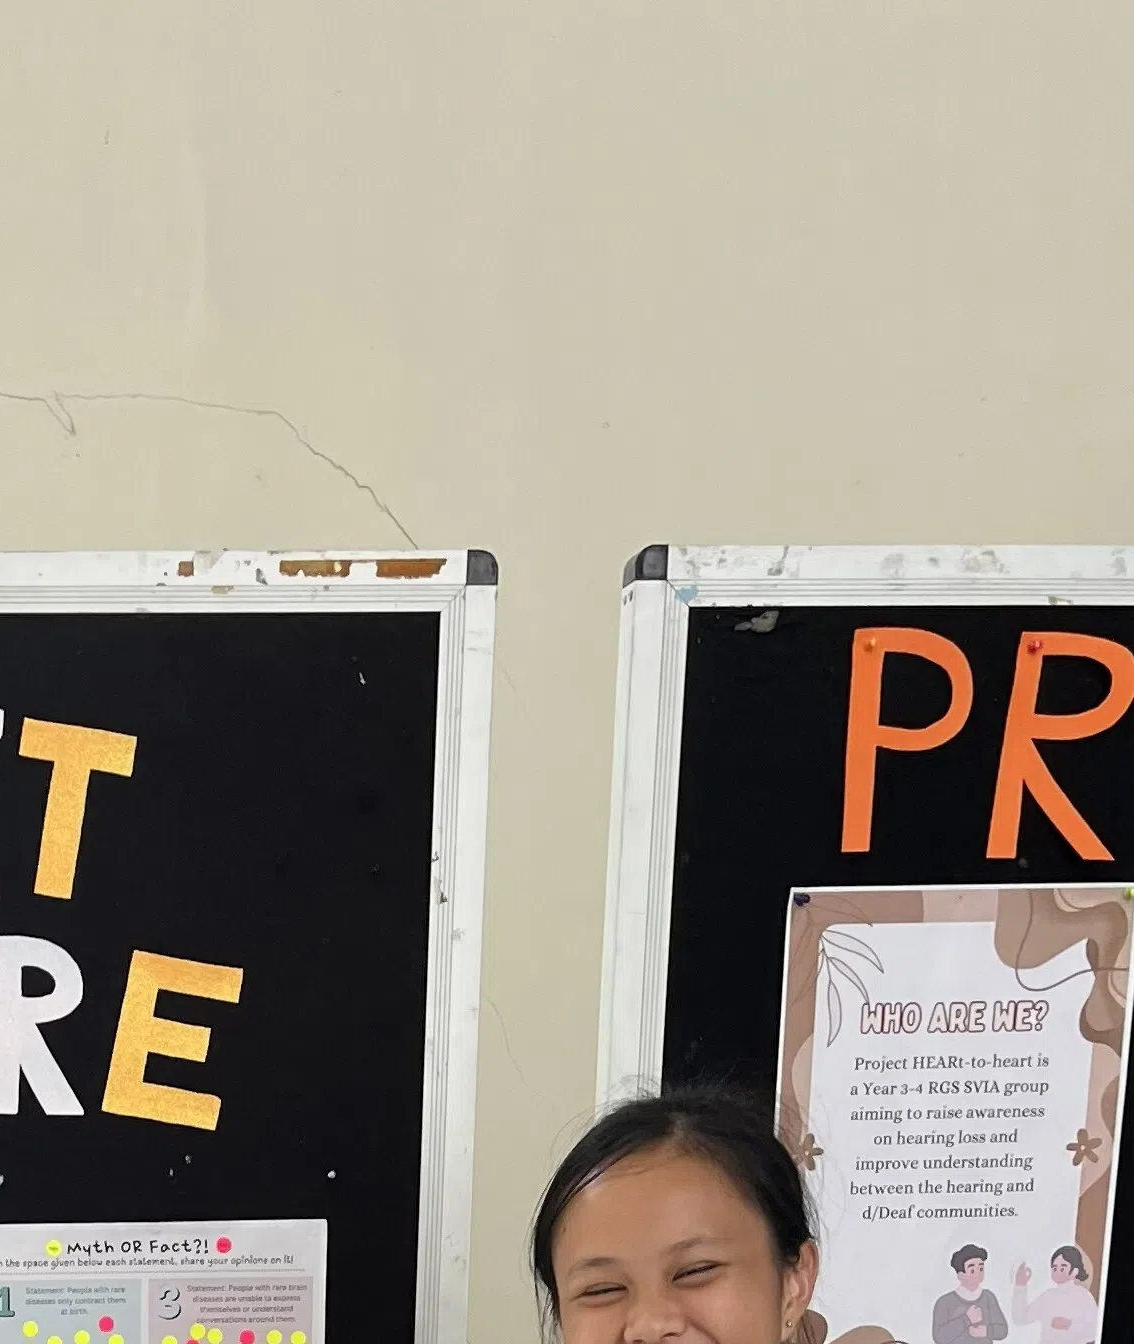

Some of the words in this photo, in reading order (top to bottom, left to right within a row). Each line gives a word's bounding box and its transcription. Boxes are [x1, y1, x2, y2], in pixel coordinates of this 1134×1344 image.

[860, 1002, 922, 1034] WHO
[927, 1001, 986, 1033] ARE
[992, 1000, 1049, 1032] WE?
[854, 1056, 907, 1073] Project
[913, 1054, 1032, 1069] HEARt-to-heart
[1037, 1053, 1049, 1067] is
[850, 1085, 858, 1096] a
[862, 1083, 897, 1095] Year
[900, 1083, 923, 1095] 3-4
[929, 1081, 960, 1094] RGS
[964, 1080, 1000, 1093] SVIA
[1004, 1082, 1049, 1096] group
[850, 1108, 902, 1123] aiming
[907, 1108, 922, 1119] to
[926, 1106, 963, 1119] raise
[966, 1106, 1045, 1118] awareness
[873, 1135, 892, 1145] on
[897, 1131, 954, 1147] hearing
[958, 1131, 986, 1144] loss
[990, 1129, 1018, 1143] and
[856, 1157, 918, 1173] improve
[923, 1154, 1034, 1170] understanding
[850, 1181, 913, 1195] between
[918, 1180, 942, 1194] the
[946, 1179, 1003, 1195] hearing
[1007, 1179, 1034, 1192] and
[862, 1205, 915, 1222] d/Deaf
[916, 1204, 1019, 1218] communities.
[67, 1241, 114, 1256] Myth
[121, 1241, 142, 1254] OR
[150, 1239, 209, 1254] Fact?!
[6, 1259, 19, 1267] the
[23, 1260, 48, 1269] space
[51, 1258, 75, 1270] given
[129, 1257, 178, 1268] statement,
[181, 1257, 204, 1265] share
[208, 1257, 228, 1267] your
[231, 1255, 267, 1266] opinions
[158, 1286, 181, 1320] 3
